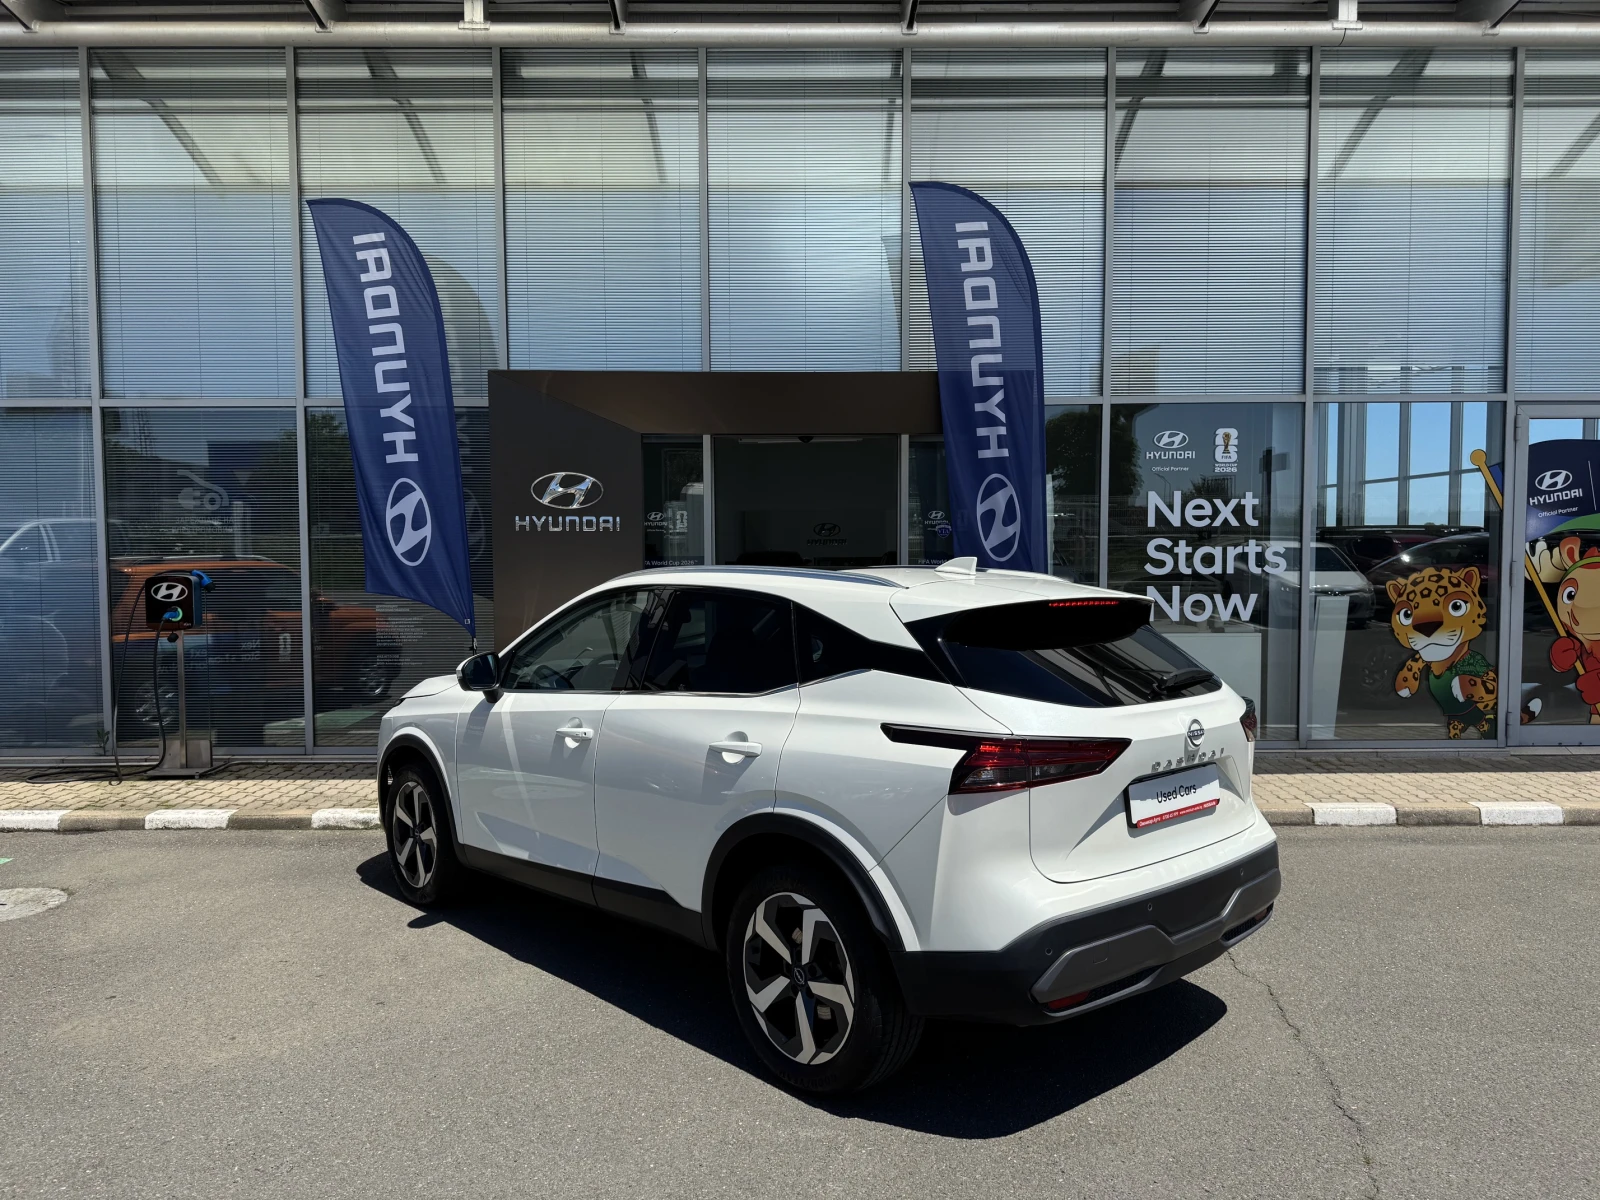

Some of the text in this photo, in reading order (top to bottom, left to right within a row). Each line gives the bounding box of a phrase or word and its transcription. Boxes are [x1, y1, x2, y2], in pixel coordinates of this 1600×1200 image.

[353, 232, 419, 464] HYUNDAI
[955, 222, 1009, 459] HYUNDAI
[1146, 451, 1195, 459] HYUNDAI
[1147, 490, 1259, 528] Next
[1529, 488, 1583, 506] HYUNDAI
[515, 515, 621, 532] HYUNDAI
[1538, 506, 1579, 518] Official Partner
[1144, 537, 1287, 576] Starts
[1146, 585, 1258, 622] Now
[1156, 784, 1197, 803] Used Cars
